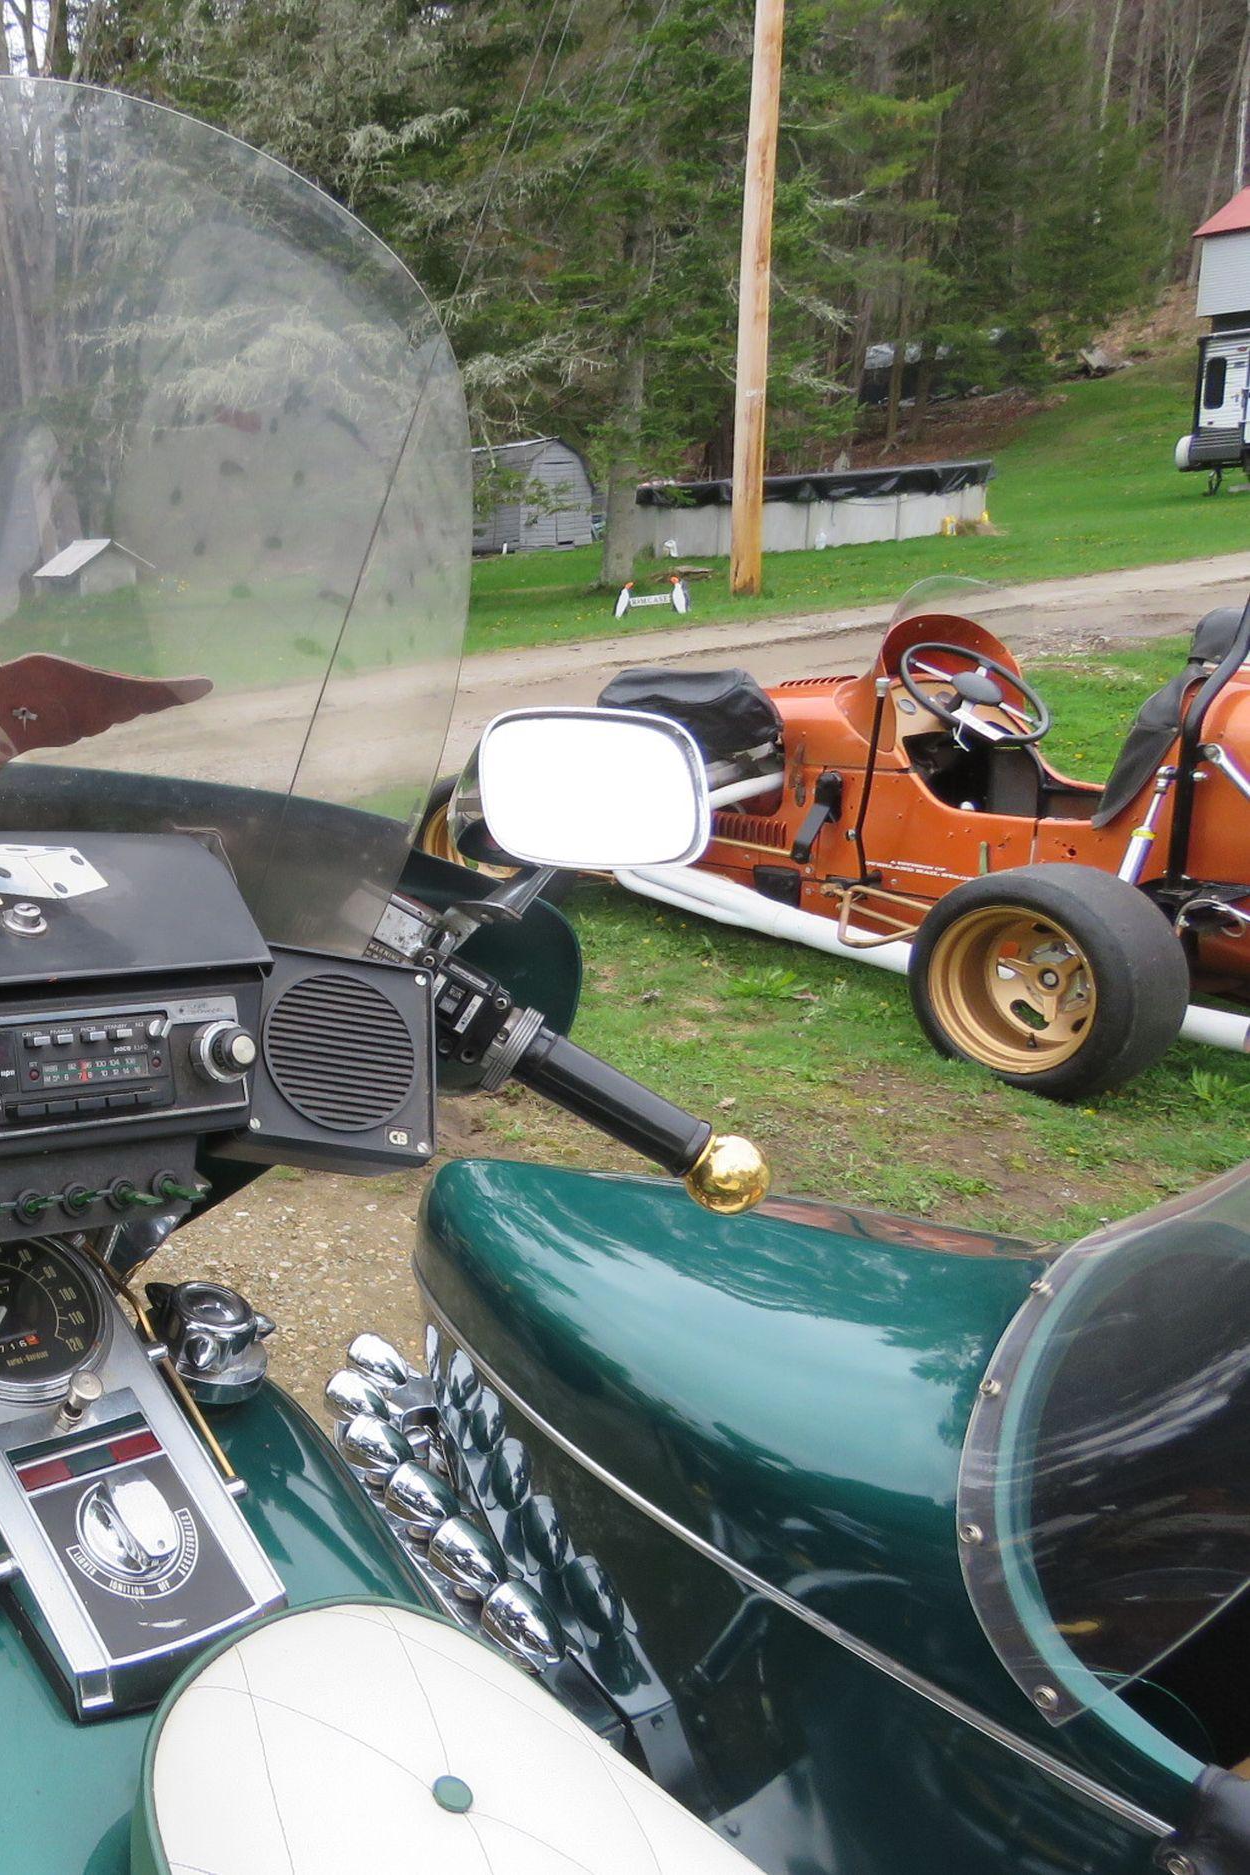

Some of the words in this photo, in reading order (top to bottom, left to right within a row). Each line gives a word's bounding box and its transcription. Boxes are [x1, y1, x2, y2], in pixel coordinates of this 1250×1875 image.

[388, 1130, 408, 1146] CB
[58, 1286, 78, 1302] 100
[68, 1310, 86, 1327] 110
[65, 1336, 85, 1353] 120
[73, 1550, 98, 1577] LIGHTS
[109, 1579, 146, 1596] IGNITION
[157, 1579, 171, 1593] OFF
[177, 1514, 196, 1578] ACCESSORIES
